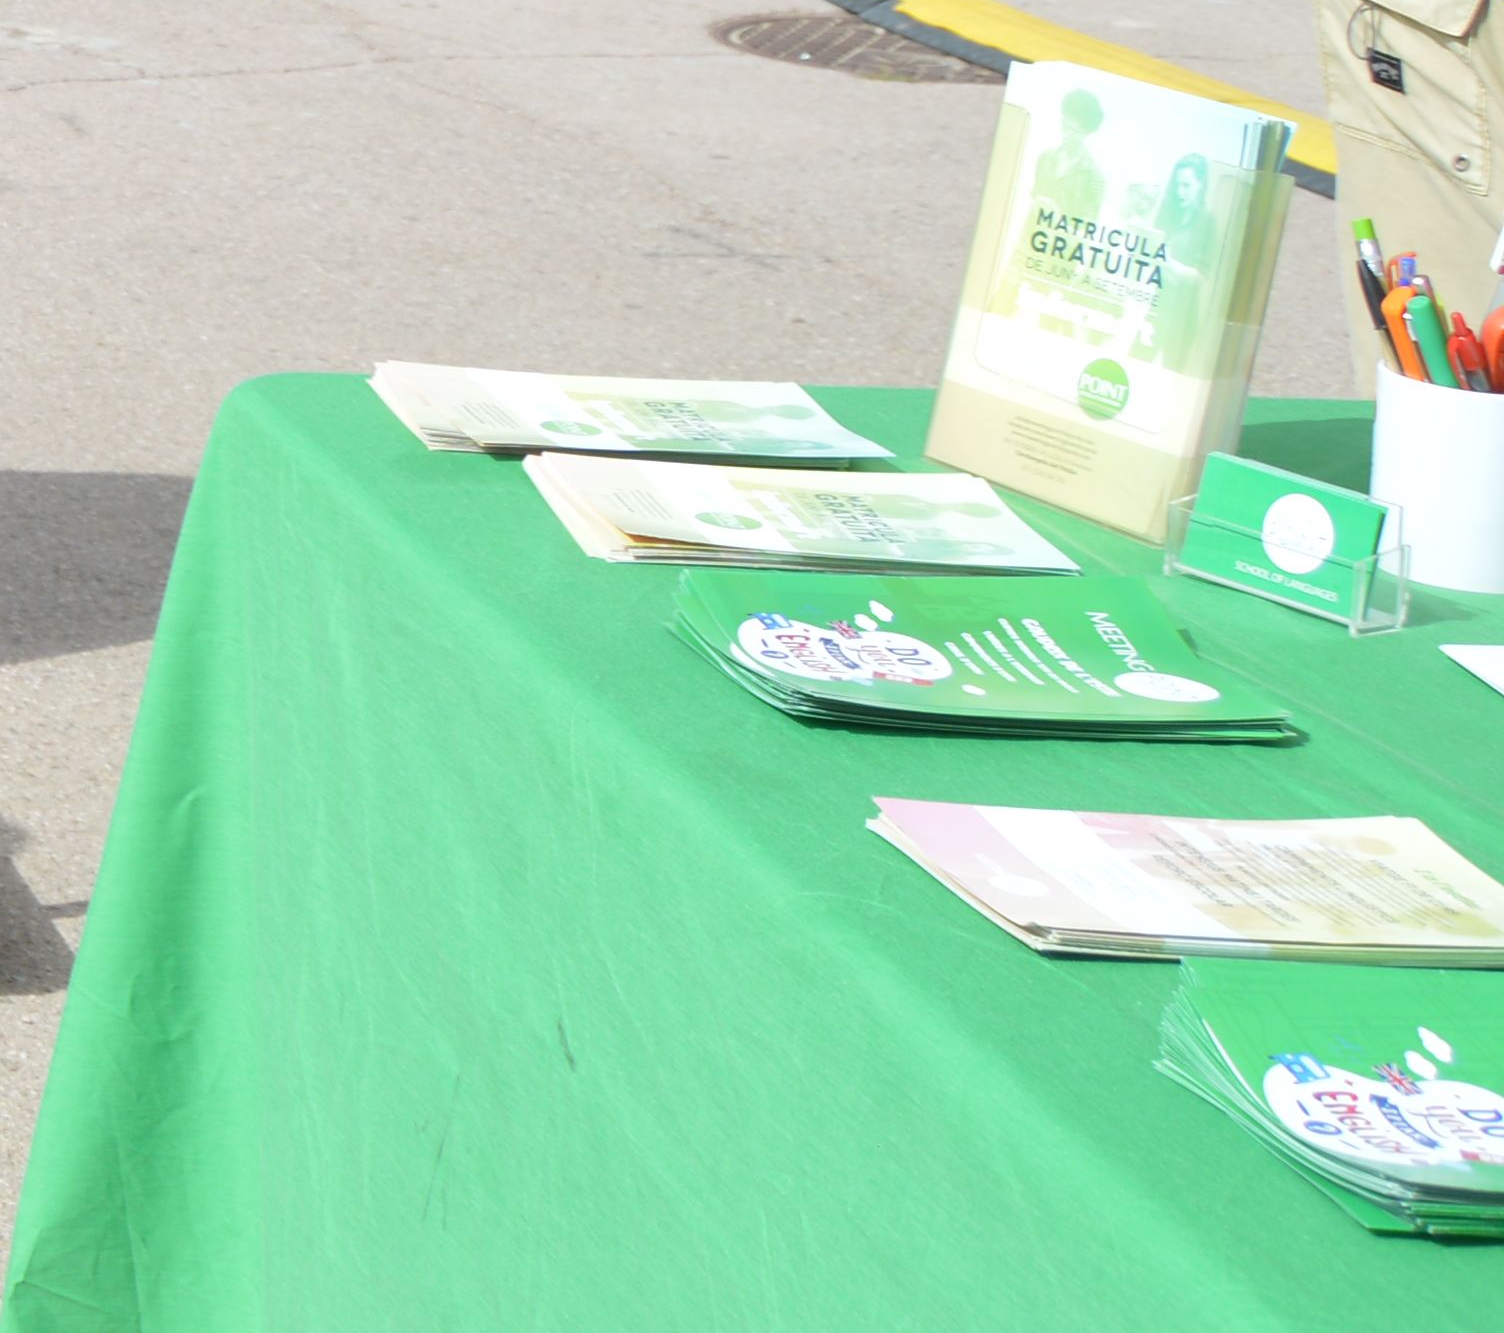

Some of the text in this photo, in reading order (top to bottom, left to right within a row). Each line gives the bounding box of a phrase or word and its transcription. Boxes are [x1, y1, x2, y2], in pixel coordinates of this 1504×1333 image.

[1035, 207, 1169, 263] MATRICULA
[1024, 257, 1043, 273] DE
[1094, 278, 1159, 307] SETEMBRE
[1078, 372, 1129, 403] POINT
[1234, 560, 1338, 603] SCHOOL OF LANGUAGES
[885, 646, 933, 666] DO
[1084, 610, 1157, 673] MEETING
[1312, 1091, 1430, 1155] ENGLISH
